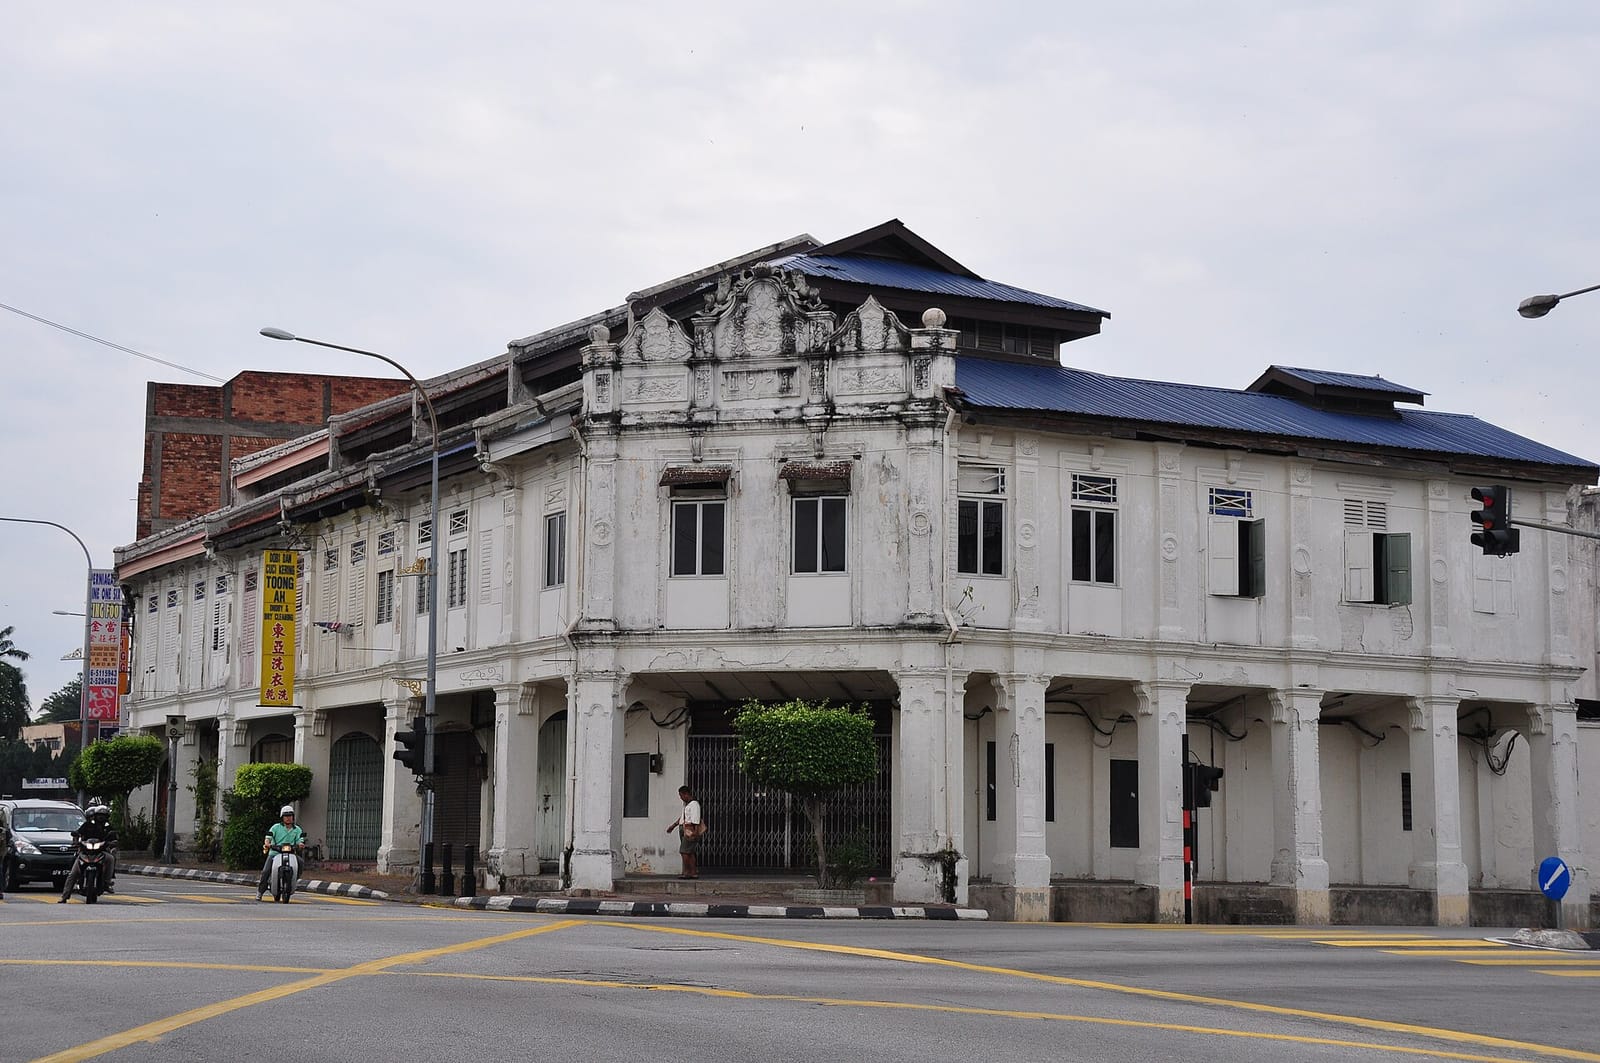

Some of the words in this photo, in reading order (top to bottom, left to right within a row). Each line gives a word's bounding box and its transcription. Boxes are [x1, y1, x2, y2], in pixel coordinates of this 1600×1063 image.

[266, 576, 294, 589] TOONG
[274, 590, 285, 603] AH
[270, 622, 286, 687] 東亞洗衣
